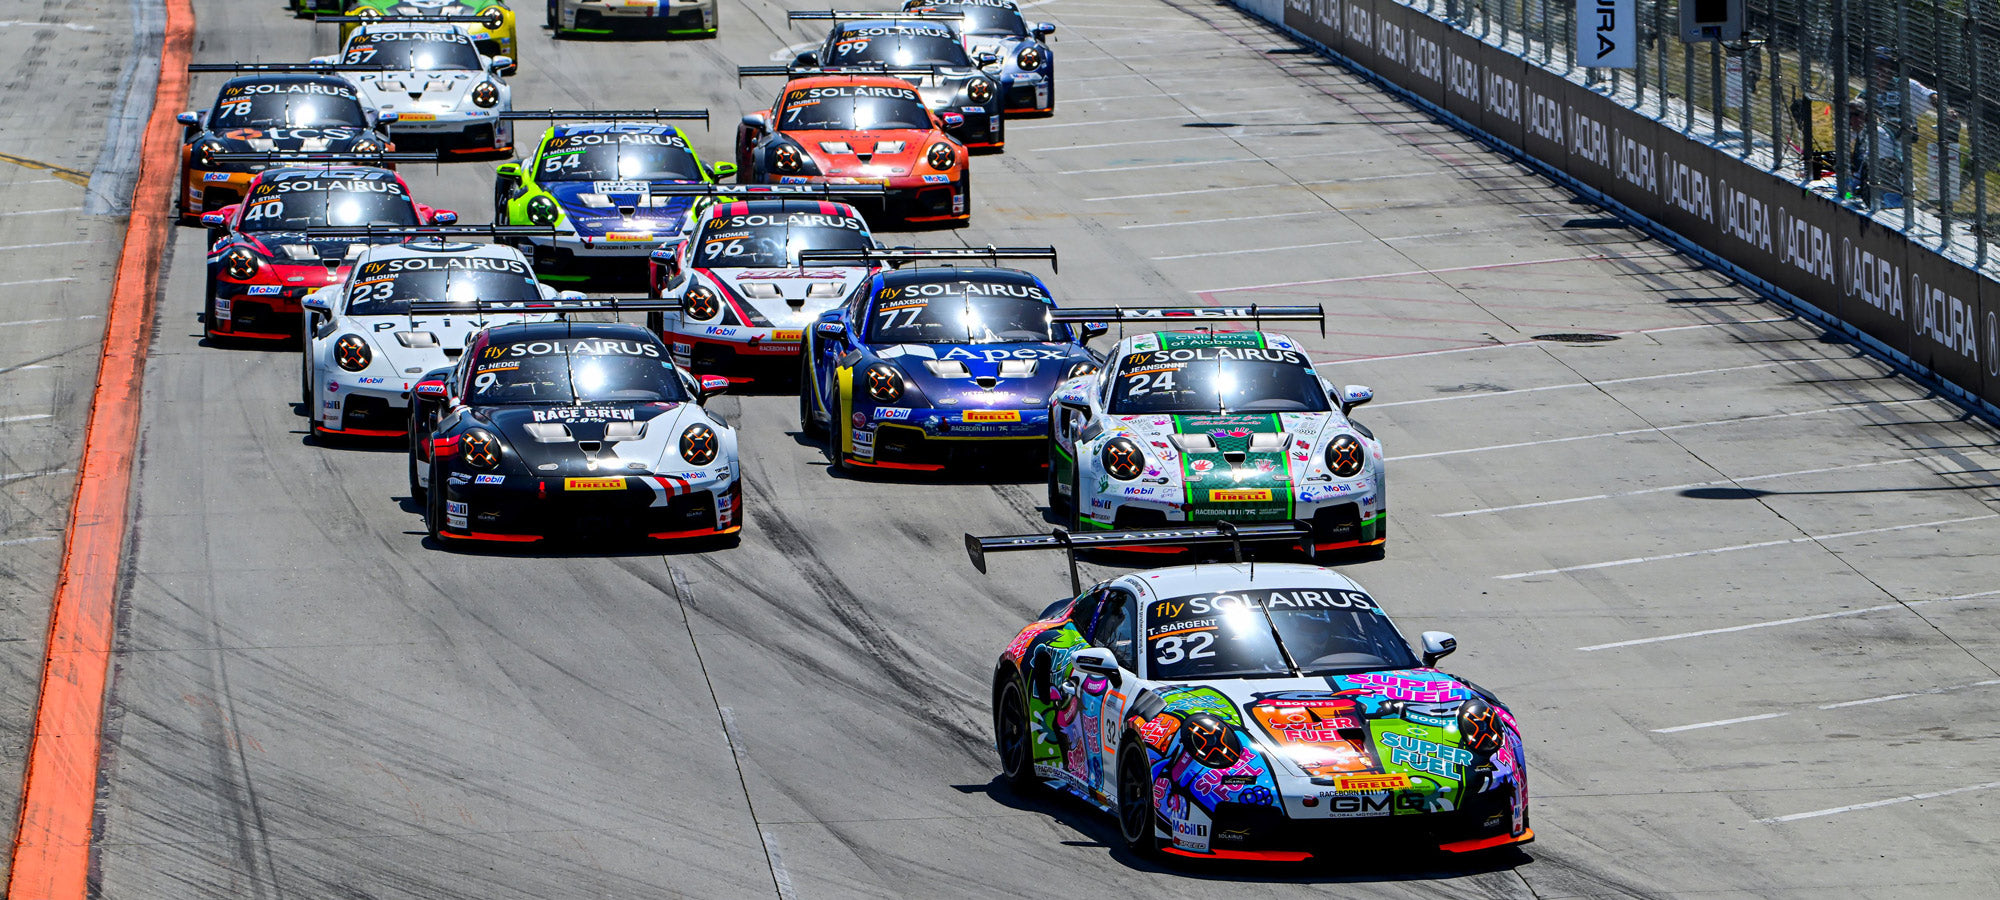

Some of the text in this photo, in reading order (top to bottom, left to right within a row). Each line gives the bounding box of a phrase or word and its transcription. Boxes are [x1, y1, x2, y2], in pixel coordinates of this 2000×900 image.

[353, 32, 468, 44] fly SOLAIRUS
[858, 27, 951, 39] SOLAIRUS
[838, 41, 868, 56] 99
[345, 49, 377, 64] 37
[1415, 36, 1443, 84] ACURA
[1451, 51, 1480, 103] ACURA
[226, 84, 350, 98] fly SOLAIRUS
[791, 87, 915, 100] fly SOLAIRUS
[1489, 72, 1521, 125] ACURA
[219, 101, 252, 119] 78
[786, 106, 802, 123] 7
[1532, 93, 1564, 146] ACURA
[264, 127, 351, 140] tcs
[549, 134, 685, 149] fly SOLAIRUS
[1575, 113, 1609, 170] ACURA
[544, 154, 581, 173] 54
[1621, 137, 1658, 195] ACURA
[203, 173, 230, 182] Mobil
[924, 174, 949, 182] Mobil
[256, 180, 402, 195] fly SOLAIRUS
[1671, 160, 1713, 224] ACURA
[244, 201, 284, 222] 40
[708, 214, 861, 231] fly SOLAIRUS
[1728, 187, 1772, 254] ACURA
[714, 231, 750, 240] THOMAS
[651, 249, 673, 260] Mobil
[704, 239, 745, 261] 96
[1786, 215, 1835, 285] ACURA
[365, 257, 525, 274] fly SOLAIRUS
[364, 273, 399, 282] BLOUM
[1852, 246, 1904, 321] ACURA
[248, 285, 282, 294] Mobil
[353, 281, 395, 305] 23
[880, 283, 1043, 300] fly SOLAIRUS
[889, 298, 929, 308] MAXSON
[373, 316, 490, 332] priv
[879, 306, 922, 330] 77
[1923, 283, 1978, 362] ACURA
[705, 326, 736, 337] Mobil
[820, 323, 842, 332] Mobil
[1170, 338, 1256, 347] of Alabama
[1175, 333, 1248, 341] Children's
[484, 341, 660, 359] fly SOLAIRUS
[939, 347, 1070, 363] Apex
[1128, 348, 1301, 365] fly SOLAIRUS
[487, 360, 521, 370] HEDGE
[358, 376, 384, 384] Mobil
[1118, 369, 1128, 377] A.
[474, 372, 497, 396] 9
[1128, 371, 1176, 397] 24
[1063, 394, 1084, 402] Mobil
[1350, 389, 1373, 399] Mobil
[532, 408, 636, 422] RACE BREW
[875, 408, 909, 419] Mobil
[967, 412, 1015, 420] PIRELLI
[476, 475, 503, 484] Mobil
[681, 471, 707, 480] Mobil
[569, 480, 621, 489] PIRELLI
[1124, 487, 1154, 495] Mobil
[1323, 483, 1352, 492] Mobil
[1214, 491, 1267, 501] PIRELLI
[1195, 508, 1227, 516] RACEBORN
[1155, 591, 1371, 619] fly SOLAIRUS
[1147, 617, 1217, 636] T. SARGENT
[1155, 630, 1217, 666] 32
[1361, 683, 1462, 703] FUEL
[1106, 718, 1117, 746] 32
[1381, 731, 1474, 767] SUPER
[1194, 746, 1257, 797] SUER
[1391, 746, 1462, 782] FUEL
[1340, 776, 1405, 790] PIRELLI
[1319, 789, 1359, 798] RACEBORN
[1330, 792, 1425, 813] GMG
[1172, 819, 1207, 836] Mobil 1
[1218, 833, 1244, 841] SOLAIRUS
